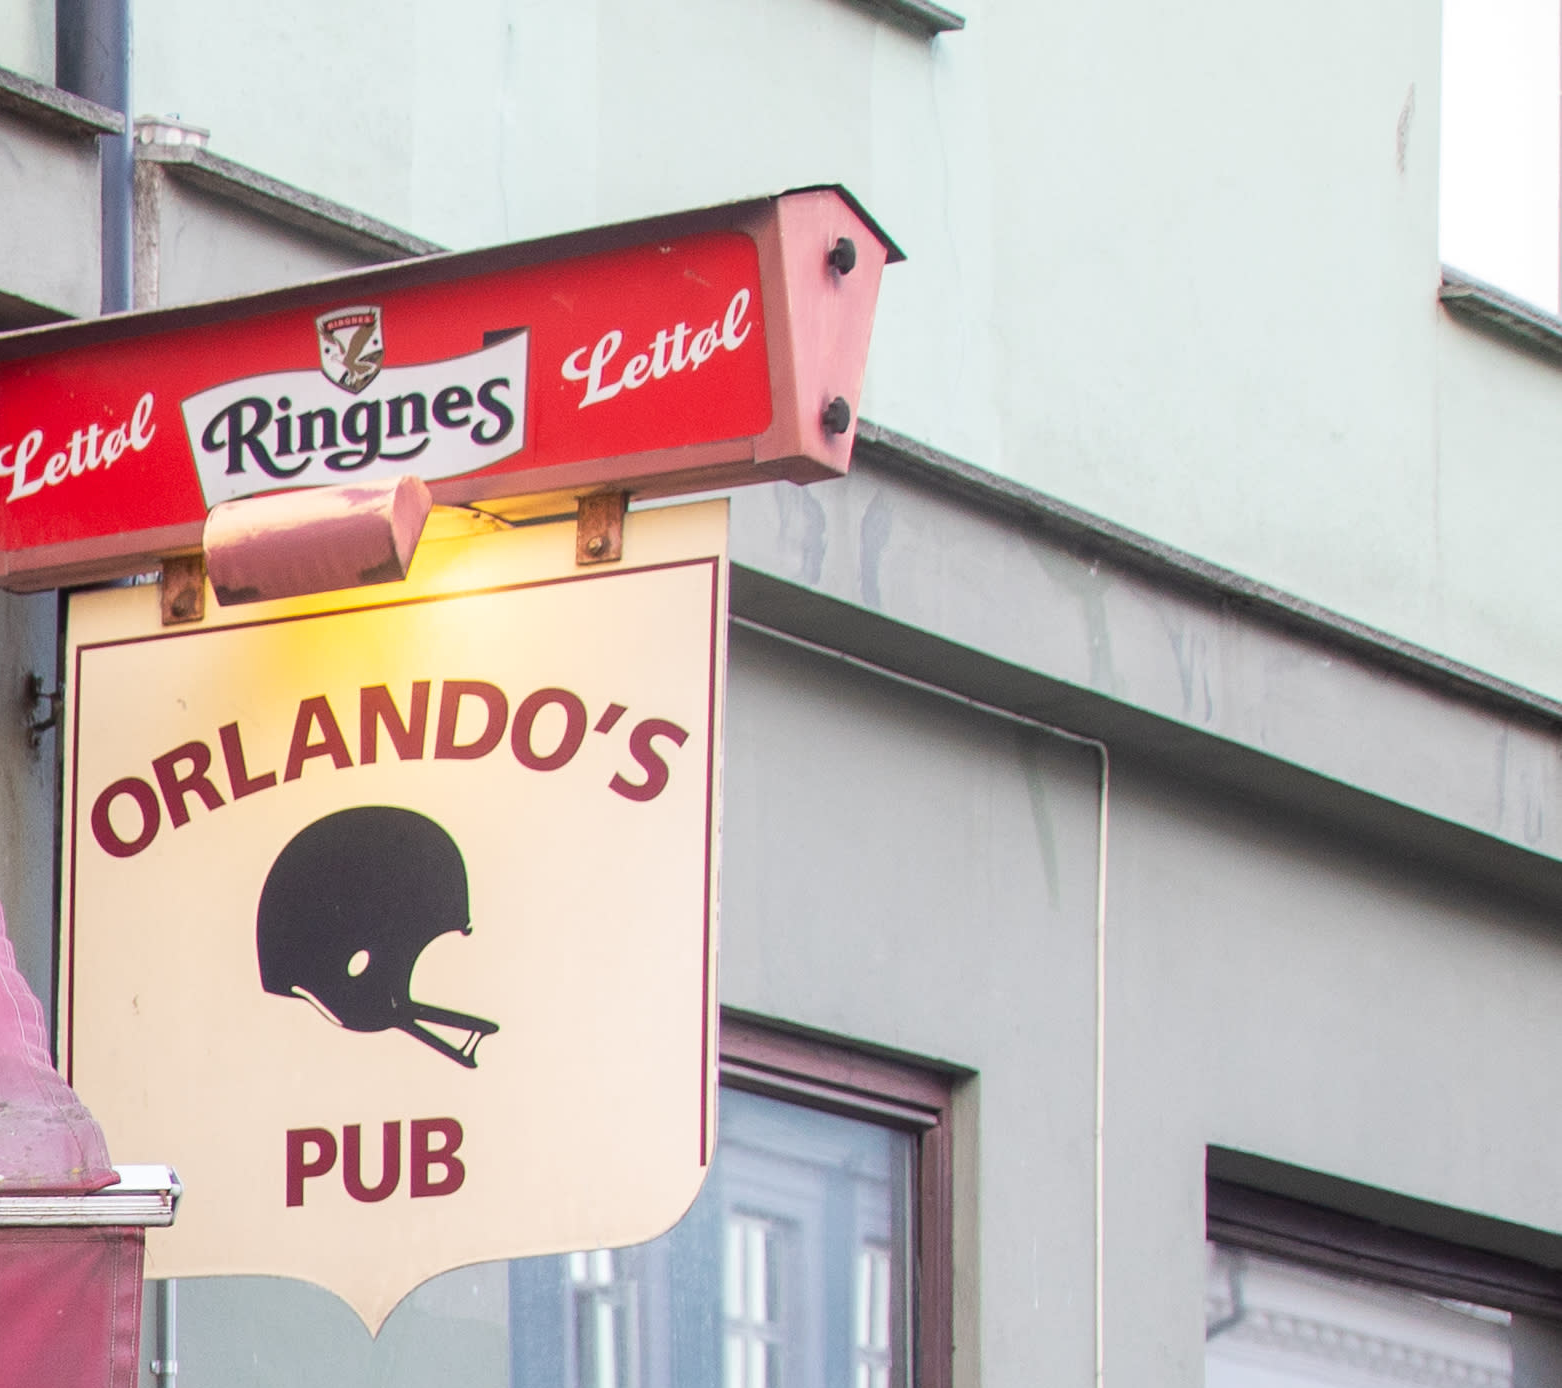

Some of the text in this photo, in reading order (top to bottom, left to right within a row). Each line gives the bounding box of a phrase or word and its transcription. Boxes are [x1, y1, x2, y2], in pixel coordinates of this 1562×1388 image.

[200, 376, 516, 480] Ringnes
[561, 286, 752, 409] Lettøl
[89, 679, 691, 859] ORLANDO'S
[285, 1117, 466, 1208] PUB
